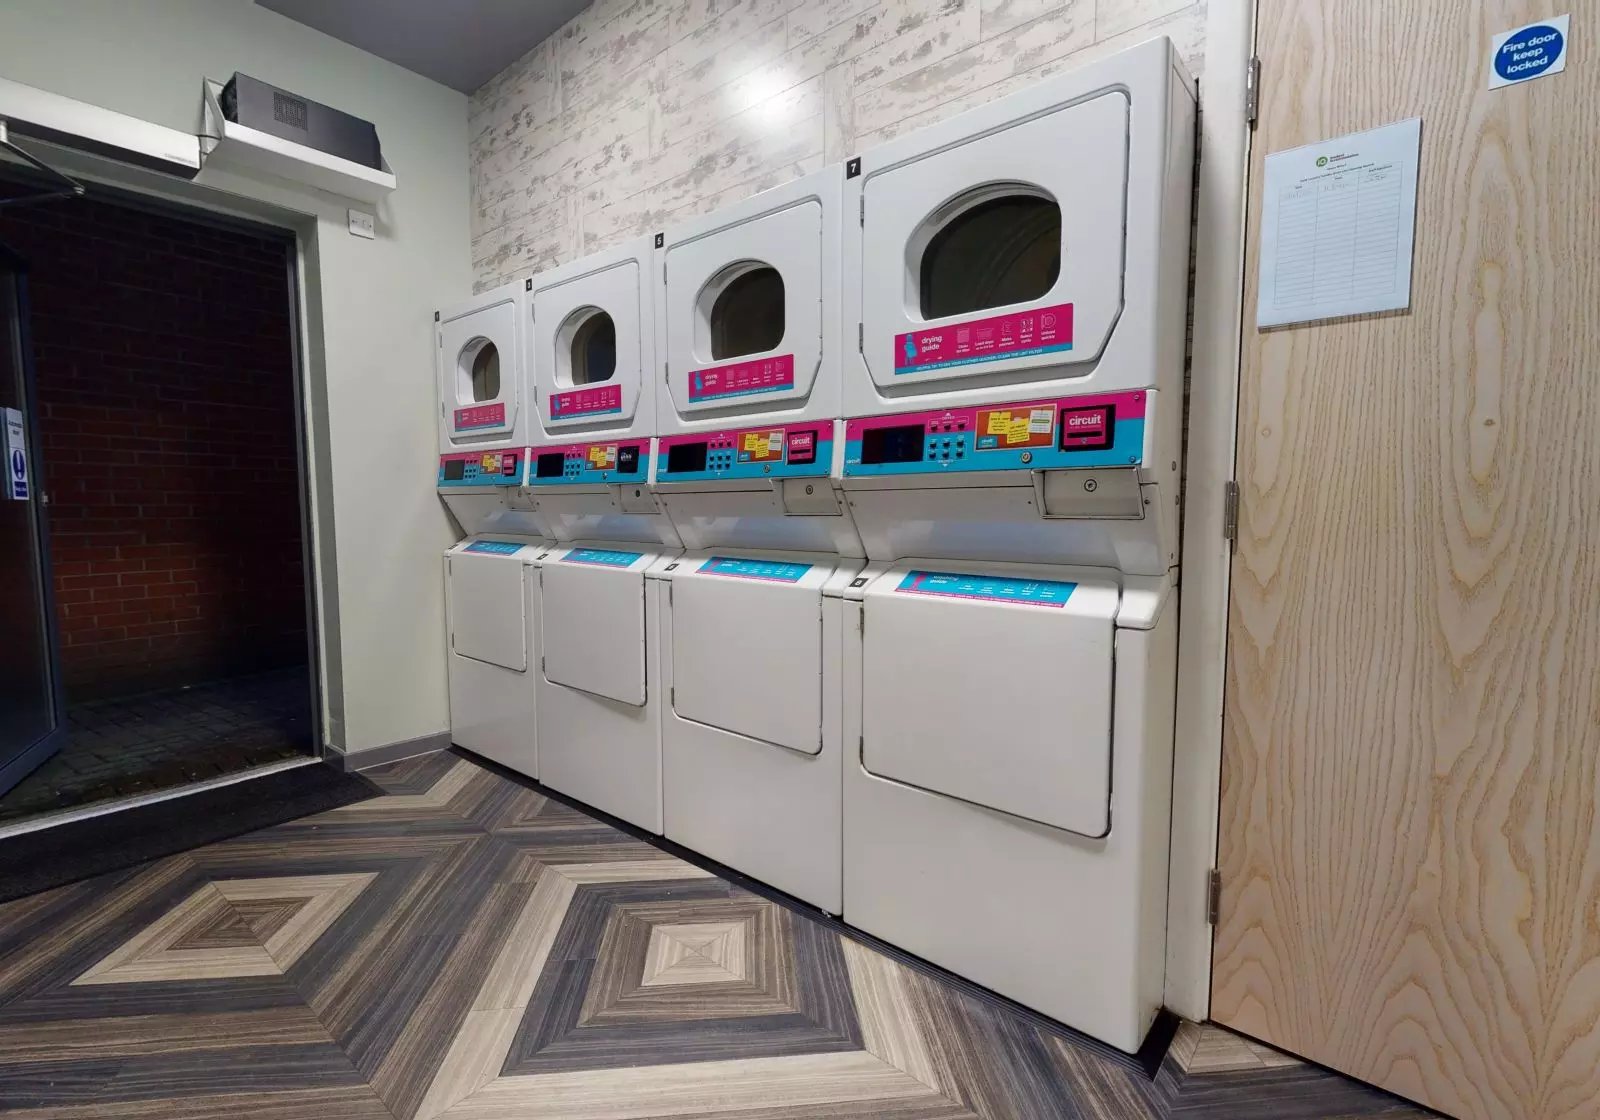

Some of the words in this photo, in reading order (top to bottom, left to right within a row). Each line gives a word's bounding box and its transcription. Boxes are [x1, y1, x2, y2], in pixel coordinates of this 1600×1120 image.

[1502, 42, 1526, 54] Fire
[1527, 32, 1559, 47] door
[1513, 47, 1543, 61] keep
[1506, 55, 1549, 74] locked
[850, 162, 857, 174] 7
[657, 236, 662, 245] 5
[921, 335, 943, 345] drying
[921, 343, 940, 353] guide
[1069, 414, 1102, 426] circuit
[791, 437, 810, 445] circuit
